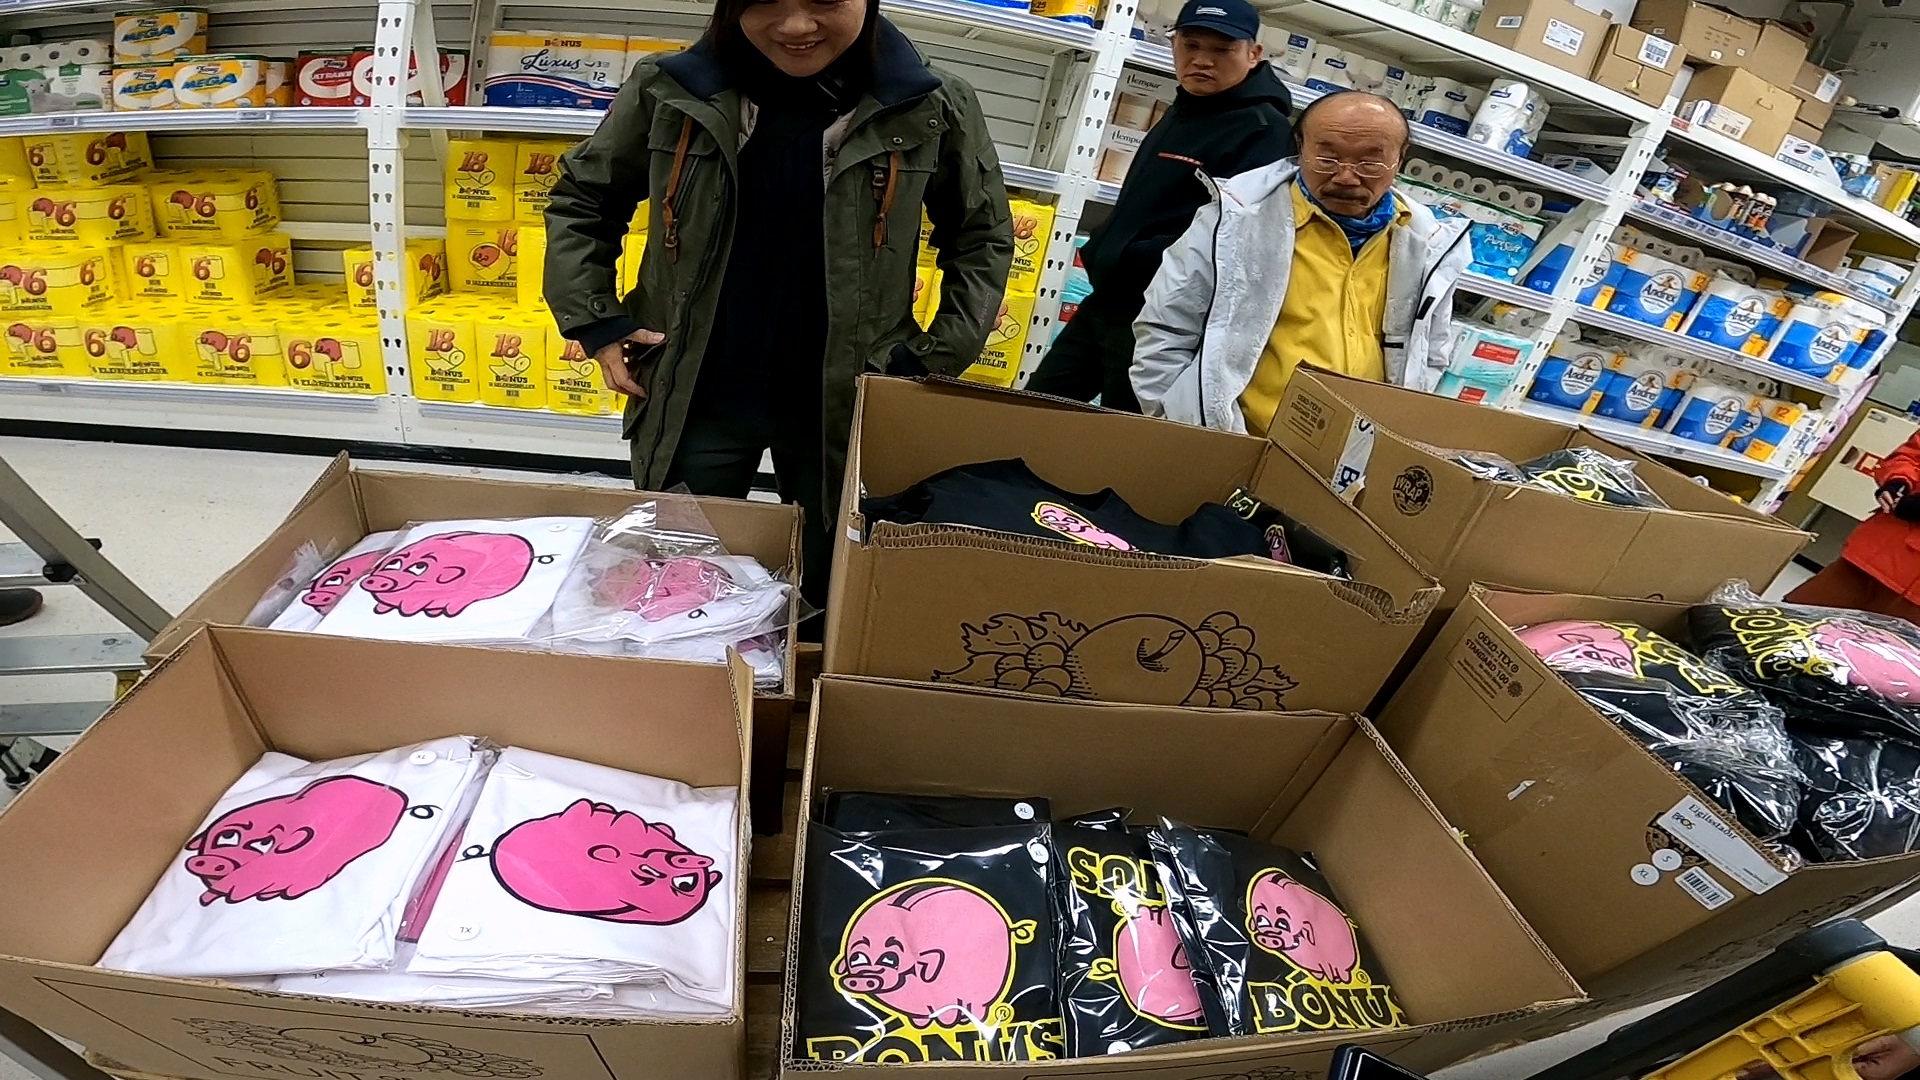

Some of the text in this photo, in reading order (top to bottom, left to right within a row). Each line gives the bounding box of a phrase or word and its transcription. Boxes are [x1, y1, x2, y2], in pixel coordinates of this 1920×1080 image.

[121, 25, 175, 42] MEGA
[119, 79, 173, 94] MEGA
[181, 74, 237, 89] MEGA
[593, 71, 606, 82] 12
[29, 146, 44, 166] 6
[86, 139, 105, 165] 6
[457, 151, 488, 172] 18
[524, 153, 554, 174] 18
[55, 200, 76, 227] 6
[108, 198, 126, 220] 6
[195, 192, 216, 217] 6
[80, 261, 95, 285] 6
[137, 256, 155, 278] 6
[194, 258, 211, 280] 6
[355, 262, 373, 287] 6
[23, 268, 47, 295] 6
[1641, 284, 1677, 302] Andrex
[34, 326, 56, 353] 6
[85, 328, 106, 357] 6
[229, 333, 251, 363] 6
[425, 329, 455, 352] 18
[490, 334, 522, 358] 18
[288, 340, 312, 369] 6
[1564, 368, 1596, 383] Andrex
[1775, 406, 1790, 419] 12
[1465, 639, 1497, 672] STANDARD
[1497, 670, 1510, 684] 100
[1662, 855, 1673, 863] S
[1637, 868, 1649, 879] XL
